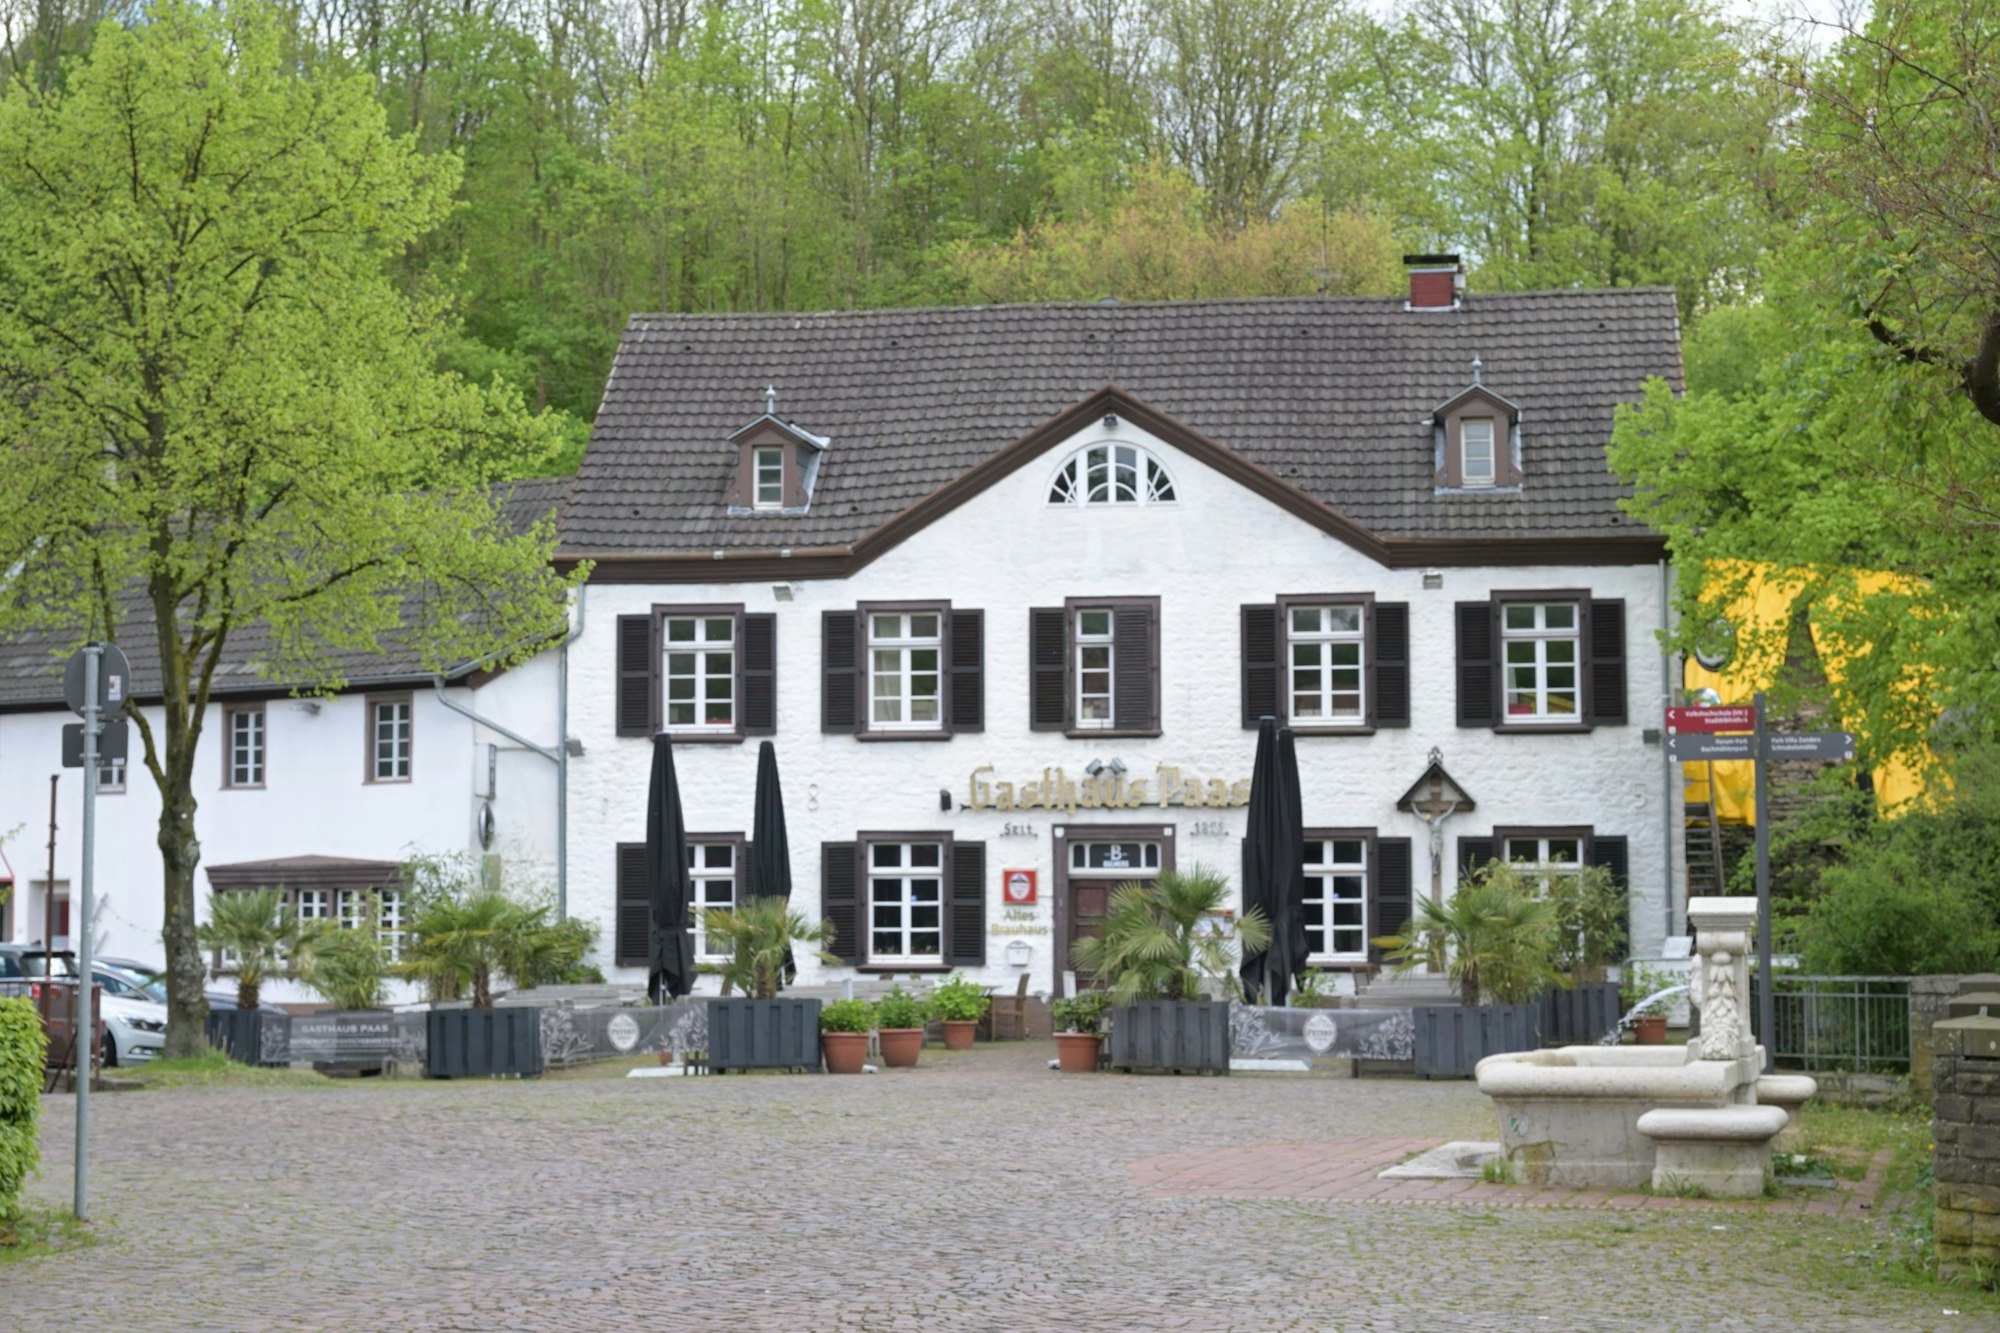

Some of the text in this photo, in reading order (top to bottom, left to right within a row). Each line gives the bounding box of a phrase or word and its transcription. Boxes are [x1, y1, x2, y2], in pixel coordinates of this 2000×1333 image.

[969, 762, 1250, 815] Gasthaus Paas
[1004, 822, 1033, 836] Seit
[1110, 844, 1123, 860] B
[1003, 910, 1036, 921] Altes
[990, 923, 1048, 936] Brauhaus
[301, 1023, 389, 1034] GASTHAUS PAAS
